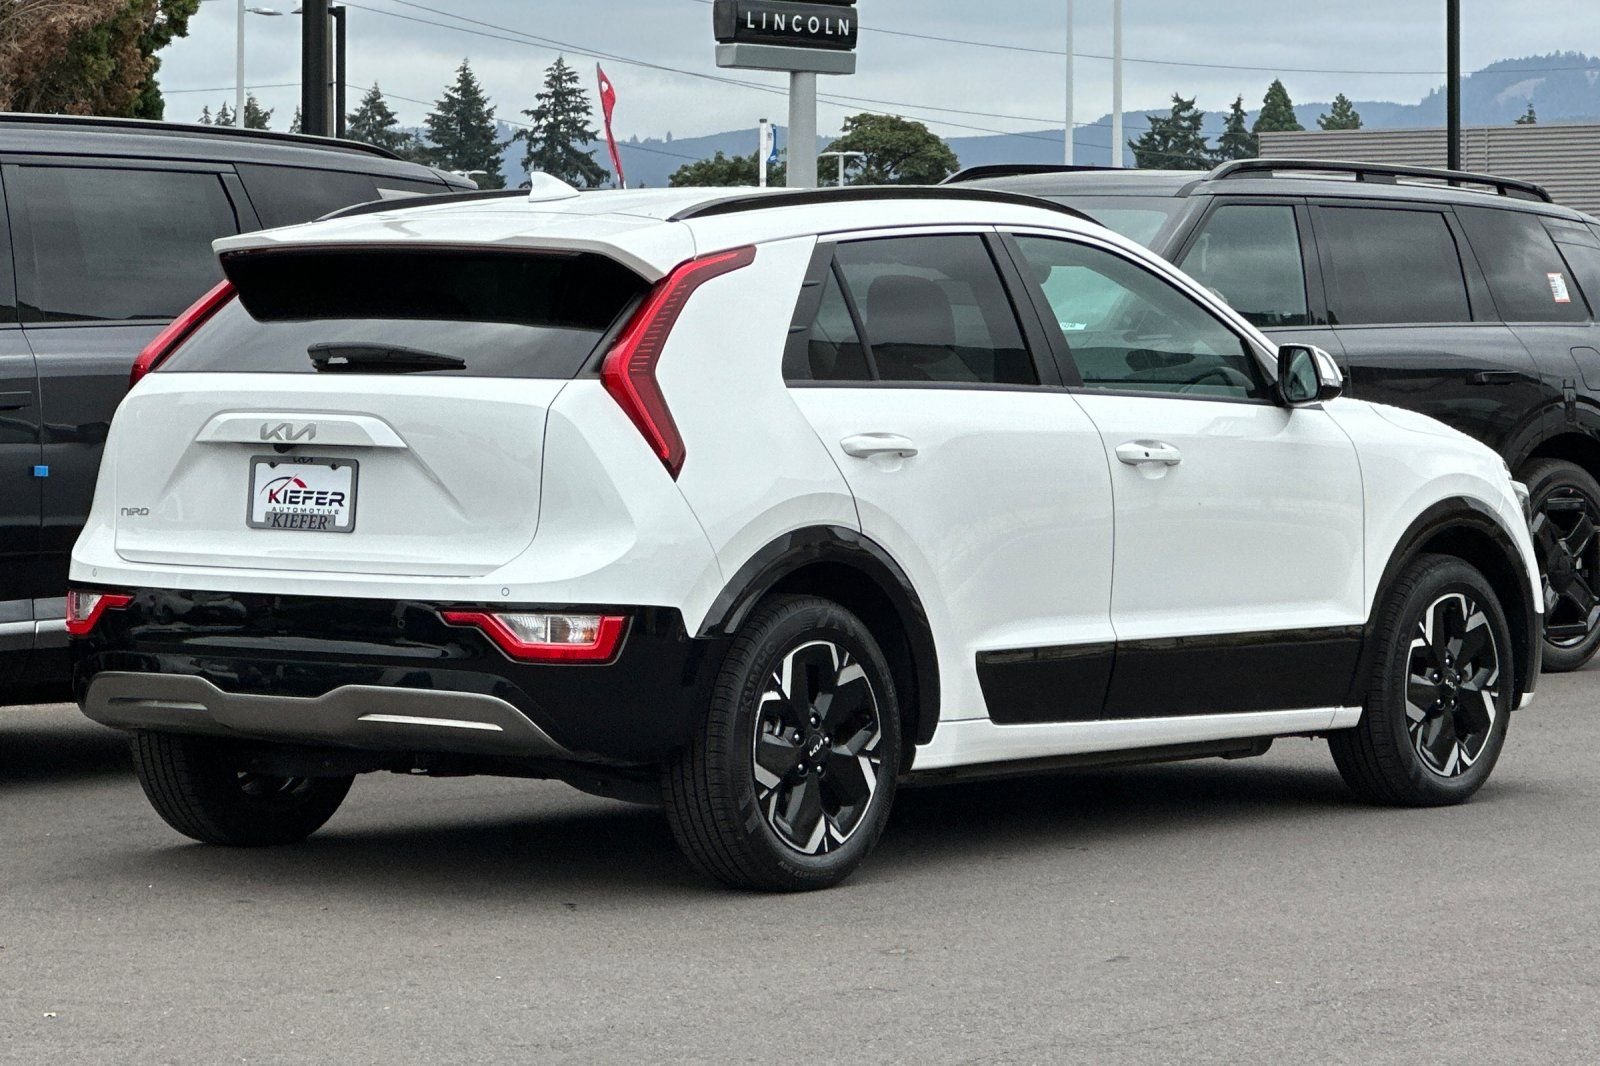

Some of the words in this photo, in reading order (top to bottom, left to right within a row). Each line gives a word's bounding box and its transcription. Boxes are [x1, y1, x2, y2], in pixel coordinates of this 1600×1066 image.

[746, 11, 849, 36] LINCOLN
[260, 422, 316, 441] KIA
[267, 488, 345, 507] KIEFER
[271, 506, 340, 515] AUTOMOTIVE
[271, 513, 328, 530] KIEFER
